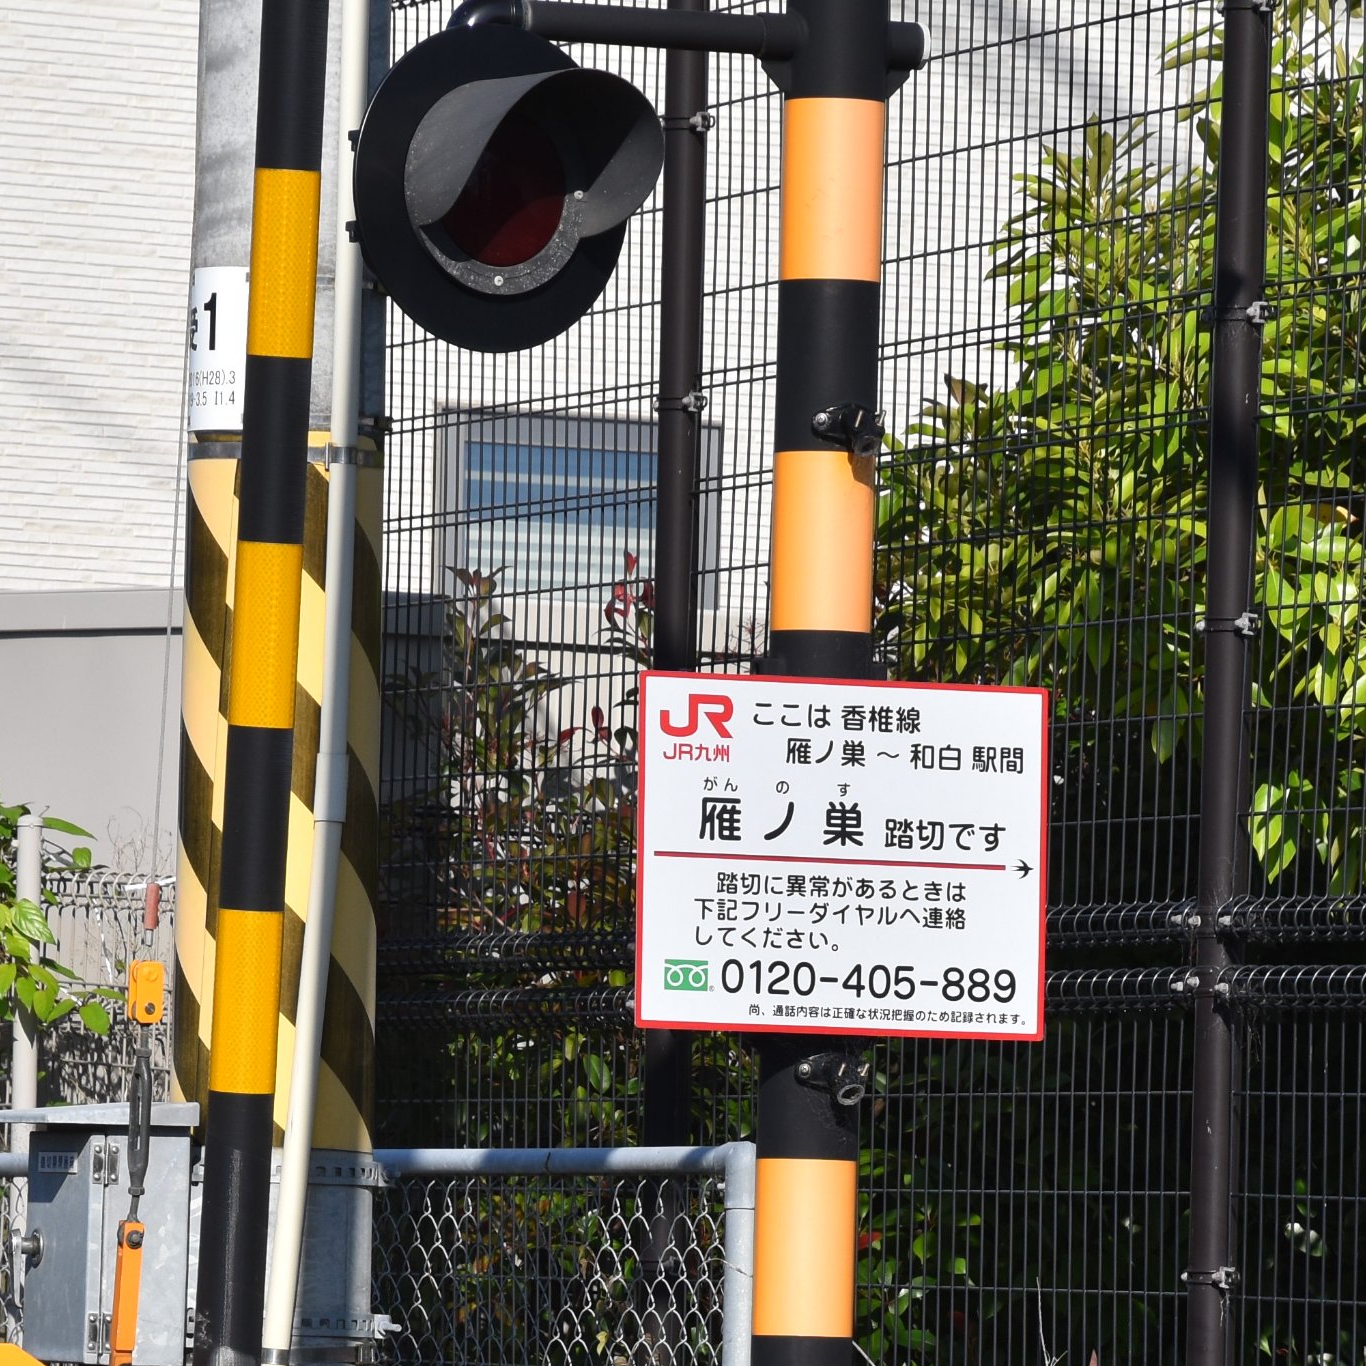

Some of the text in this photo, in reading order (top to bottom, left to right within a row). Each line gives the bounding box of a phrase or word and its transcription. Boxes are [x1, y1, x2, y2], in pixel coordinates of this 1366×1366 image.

[659, 693, 734, 739] JR
[752, 702, 922, 735] ここは 香椎線
[662, 743, 731, 763] JR九州
[785, 737, 866, 768] 雁ノ巣
[909, 743, 962, 771] 和白
[971, 746, 1025, 775] 駅間
[703, 776, 851, 797] がん の す
[698, 796, 1007, 852] 雁ノ巣 踏切です
[716, 871, 967, 904] 踏切に異常があるときは
[693, 897, 967, 931] 下記フリーダイヤルへ連絡
[694, 925, 841, 952] してください。
[720, 958, 1017, 1004] 0120-405-889
[748, 1002, 1027, 1026] 尚、通話内容は正確な状況把握のため記録されます。
